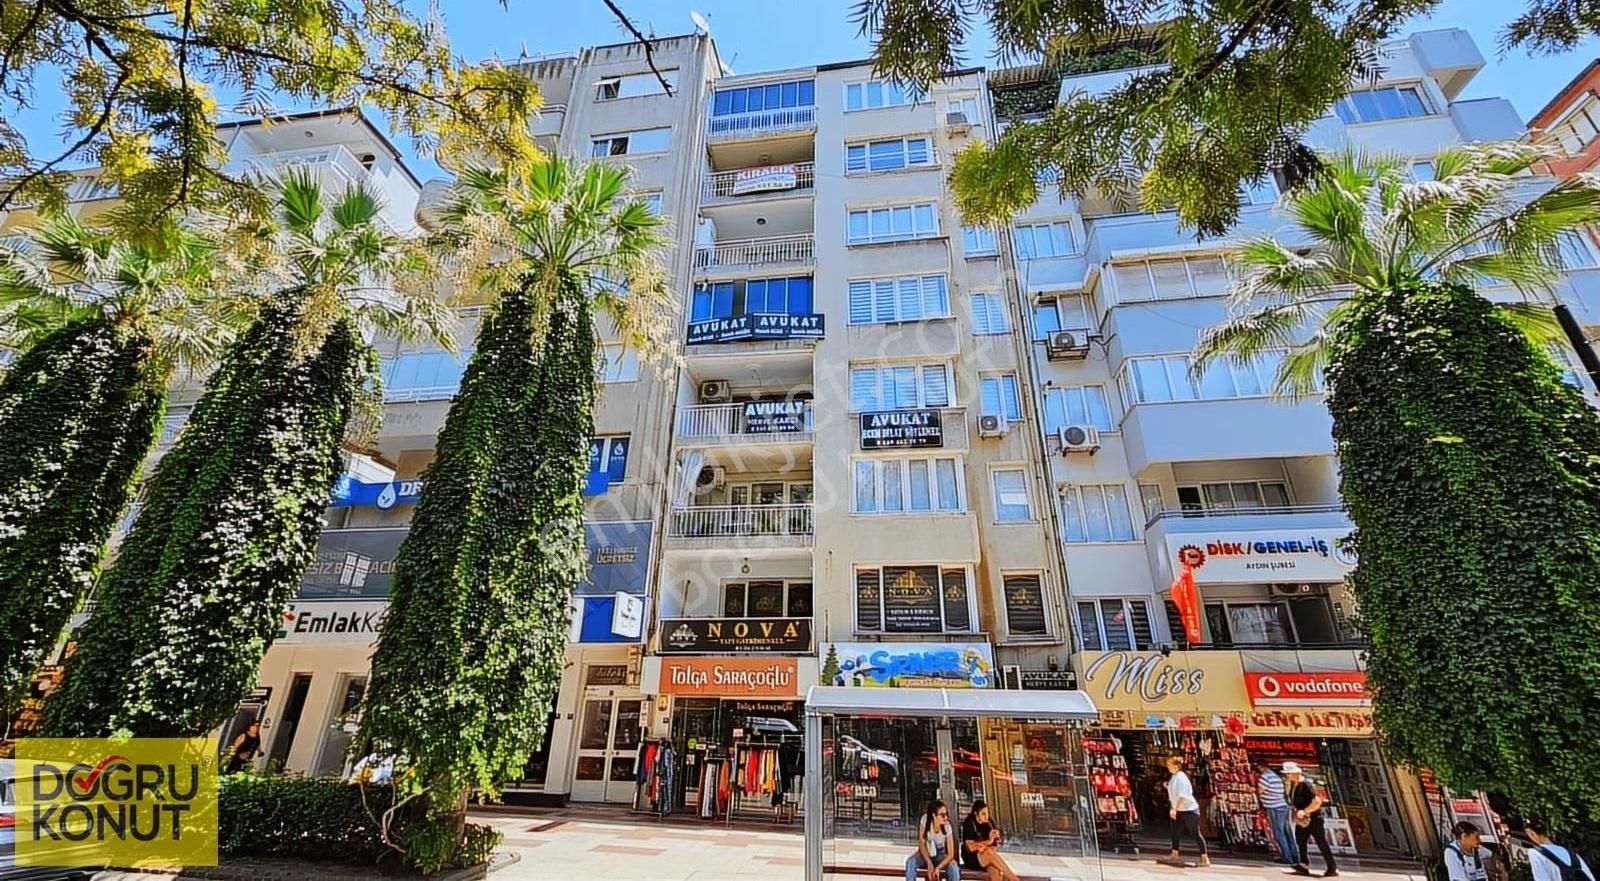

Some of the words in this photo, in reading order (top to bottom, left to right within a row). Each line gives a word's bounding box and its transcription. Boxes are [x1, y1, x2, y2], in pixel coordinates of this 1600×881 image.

[736, 164, 796, 181] KIRALIK
[693, 317, 748, 334] AVUKAT
[759, 316, 818, 327] AVUKAT
[744, 401, 803, 416] AVUKAT
[870, 412, 931, 427] AVUKAT
[706, 622, 798, 638] NOVA
[1023, 671, 1070, 680] AVUKAT
[1085, 650, 1205, 703] Miss
[1285, 678, 1364, 693] vodafone
[1252, 711, 1302, 731] GENÇ
